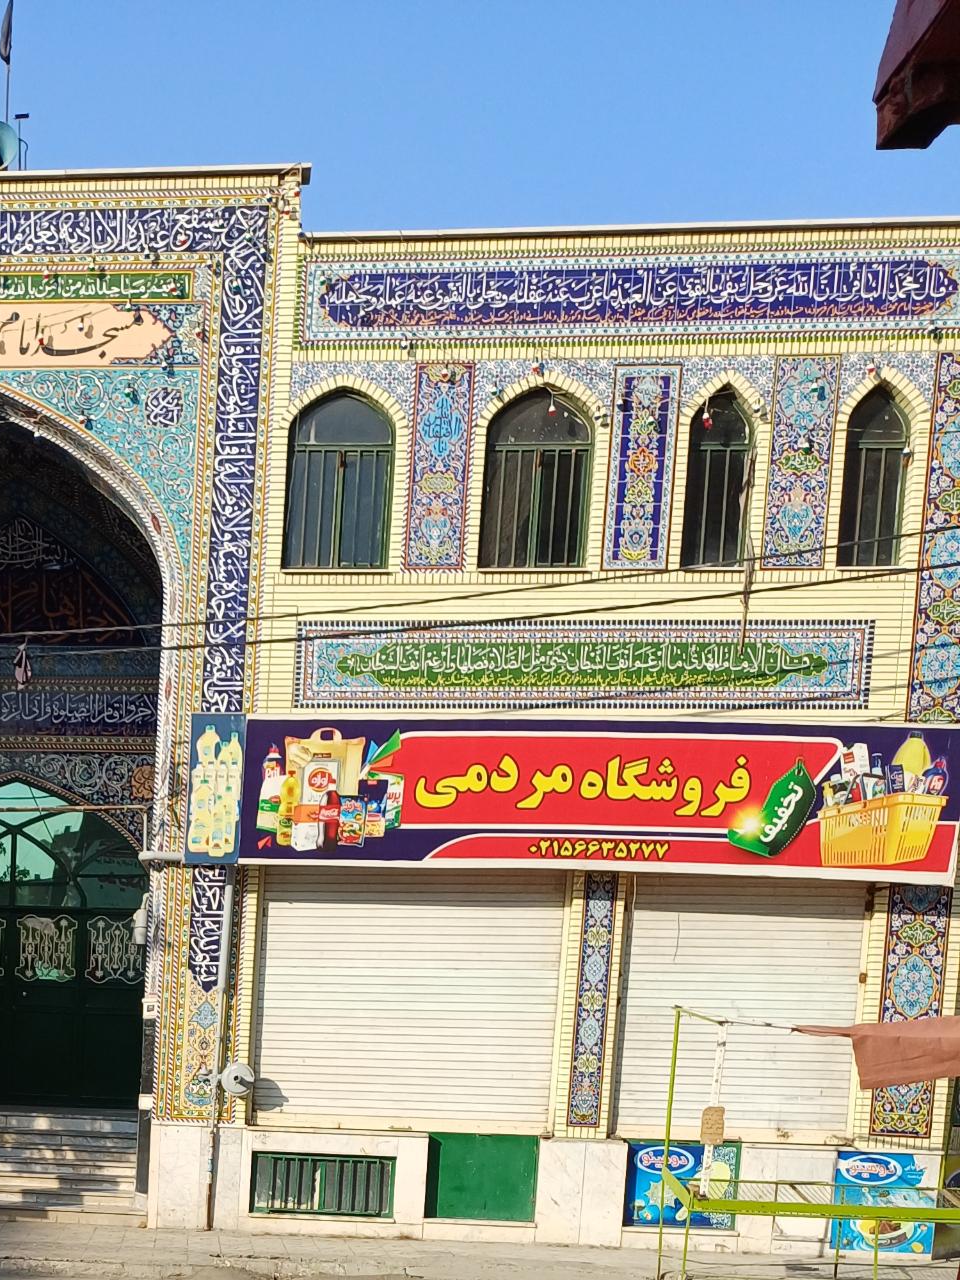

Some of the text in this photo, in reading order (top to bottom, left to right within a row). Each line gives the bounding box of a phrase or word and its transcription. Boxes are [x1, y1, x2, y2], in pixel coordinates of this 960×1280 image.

[31, 311, 144, 359] مسجد
[414, 754, 751, 817] فروشگاه مردمی
[760, 782, 804, 842] تخفیف
[528, 838, 669, 859] ۰۲۱۵۶۶۳۵۲۷۷
